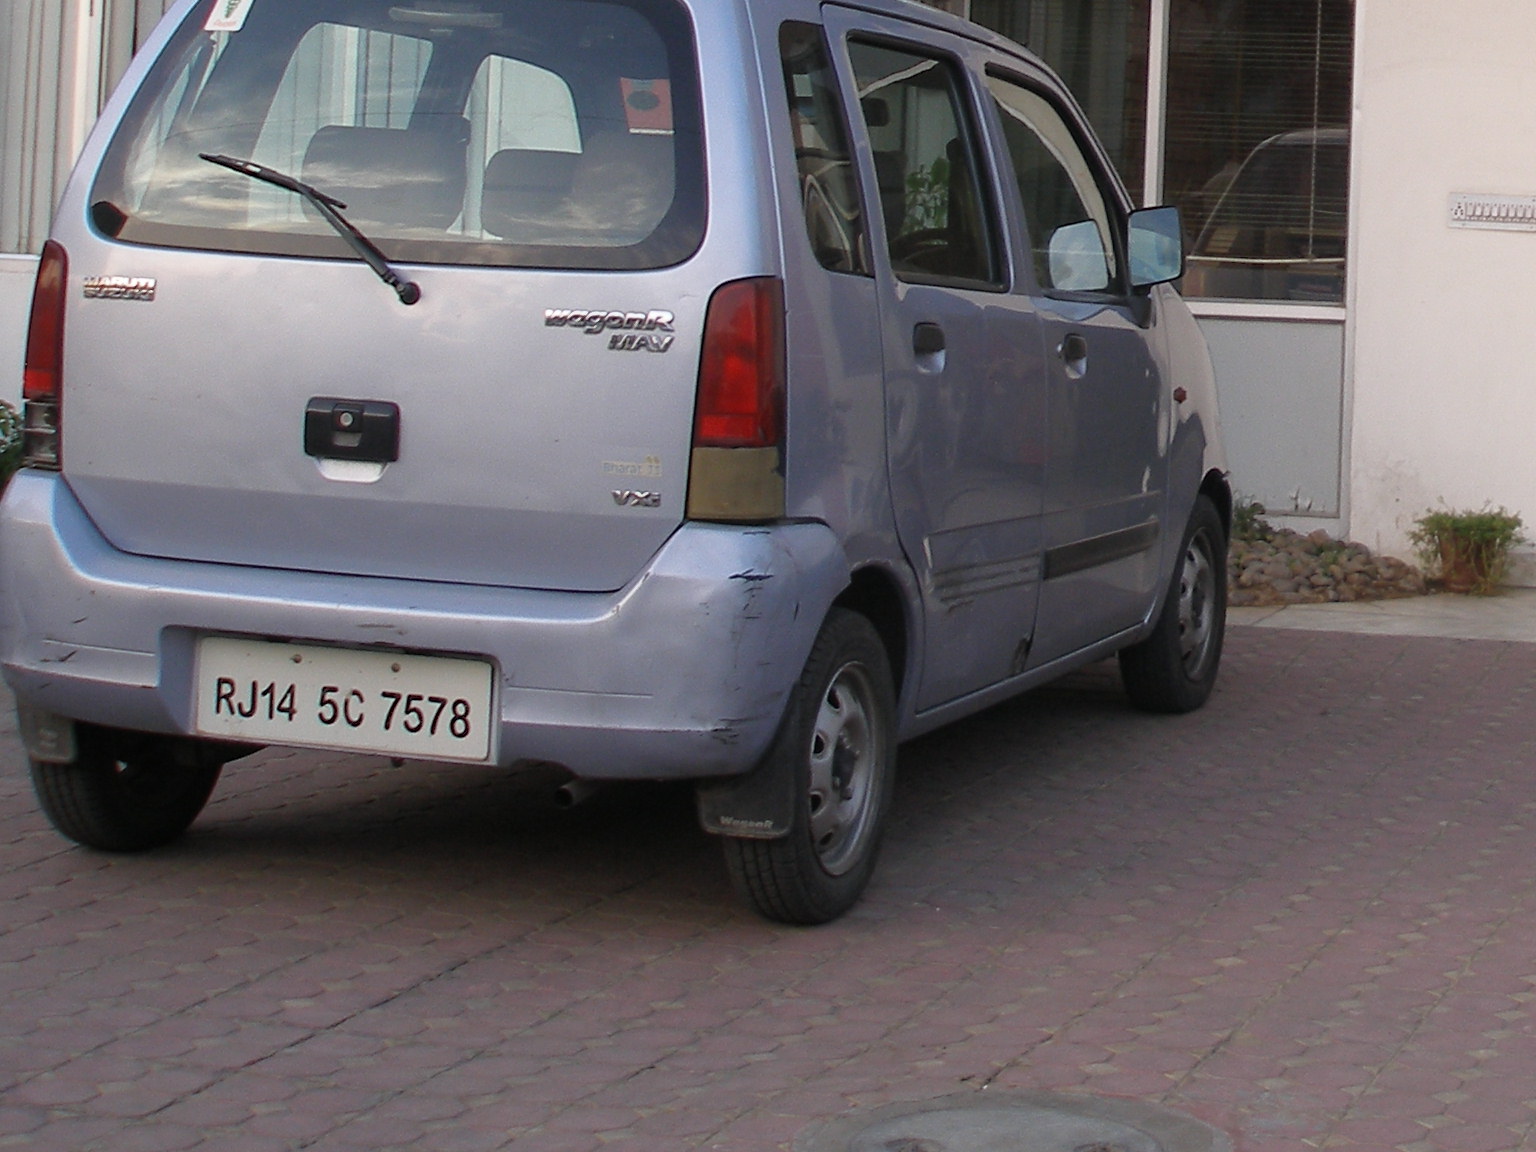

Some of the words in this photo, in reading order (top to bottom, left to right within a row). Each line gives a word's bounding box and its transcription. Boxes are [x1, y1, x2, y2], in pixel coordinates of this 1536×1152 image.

[83, 276, 157, 289] MARUTI
[83, 288, 156, 303] SUZUKI
[215, 677, 298, 721] RJ14
[318, 686, 364, 727] 5C
[381, 691, 471, 738] 7578
